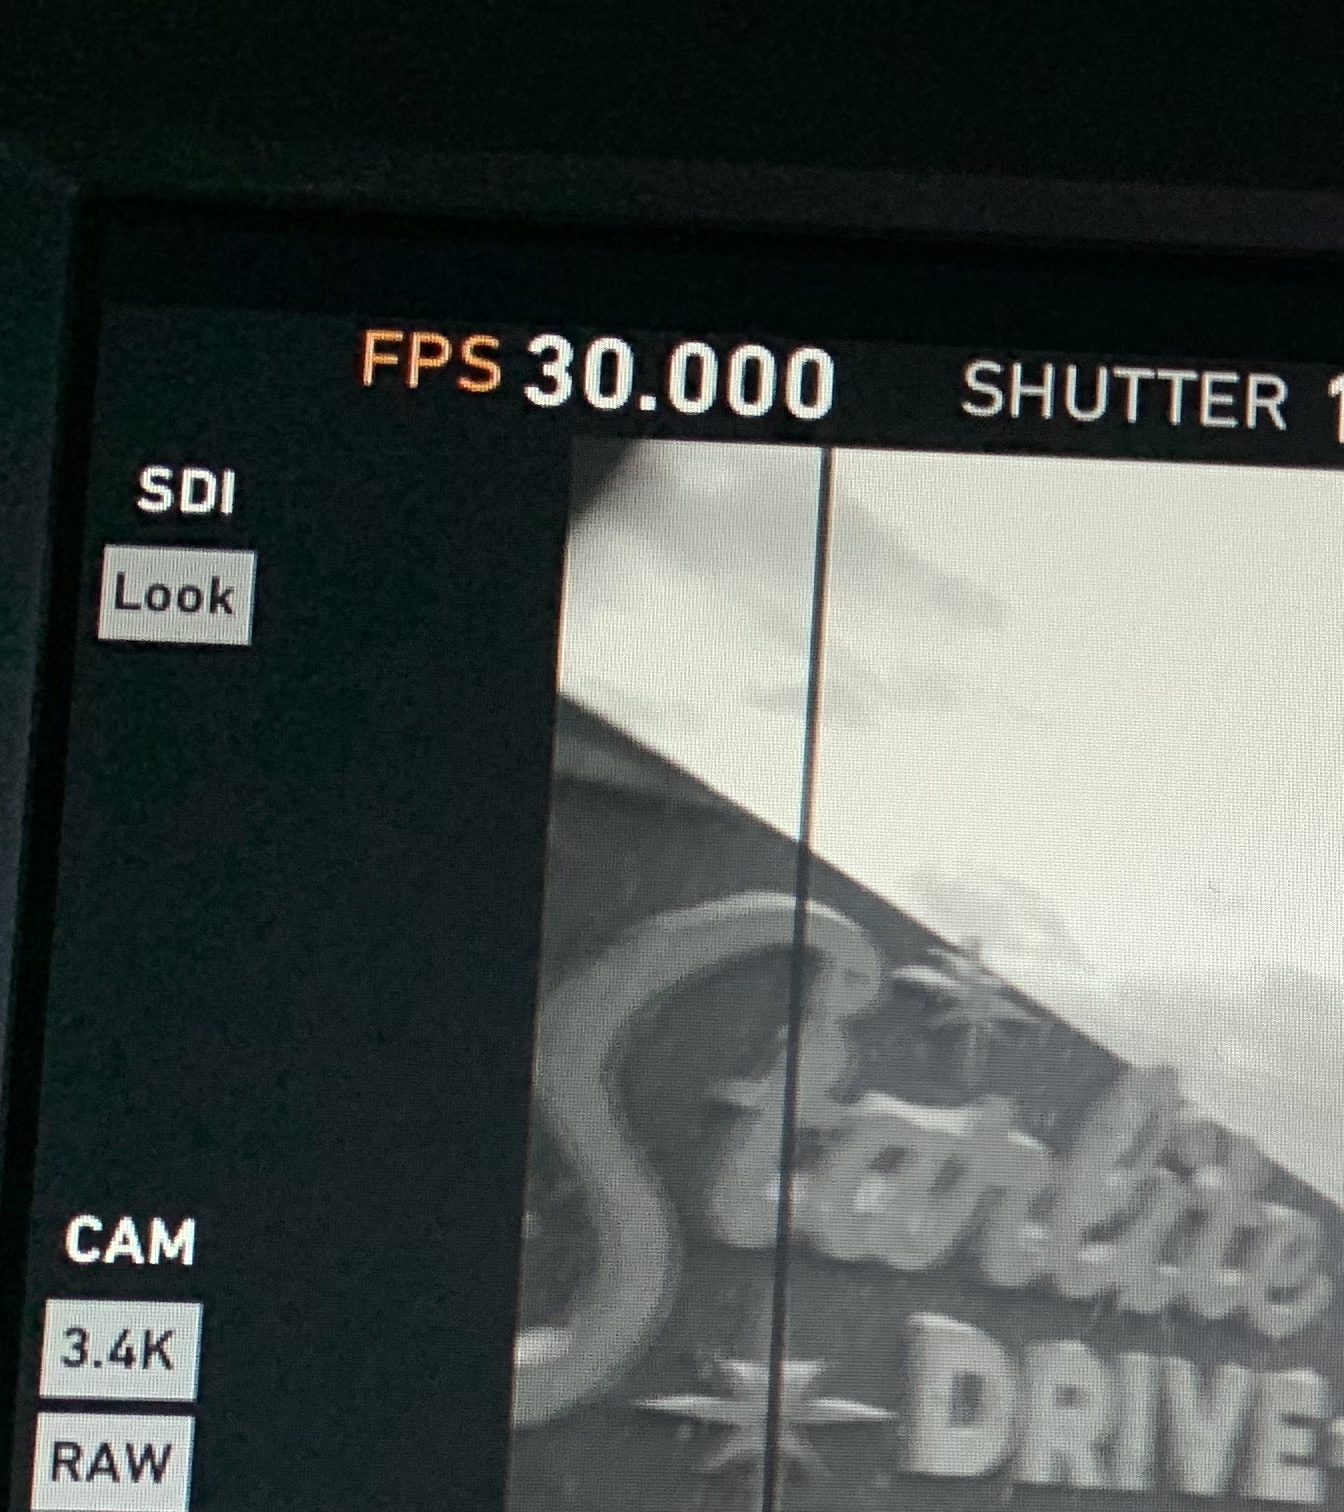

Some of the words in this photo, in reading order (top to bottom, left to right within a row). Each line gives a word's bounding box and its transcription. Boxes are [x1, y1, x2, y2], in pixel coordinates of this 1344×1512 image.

[362, 330, 502, 392] FPS
[524, 333, 835, 420] 30.000
[962, 360, 1288, 430] SHUTTER
[137, 466, 235, 515] SDI
[114, 572, 233, 615] Look
[65, 1214, 196, 1266] CAM
[62, 1326, 173, 1370] 3.4K
[51, 1440, 172, 1484] RAW
